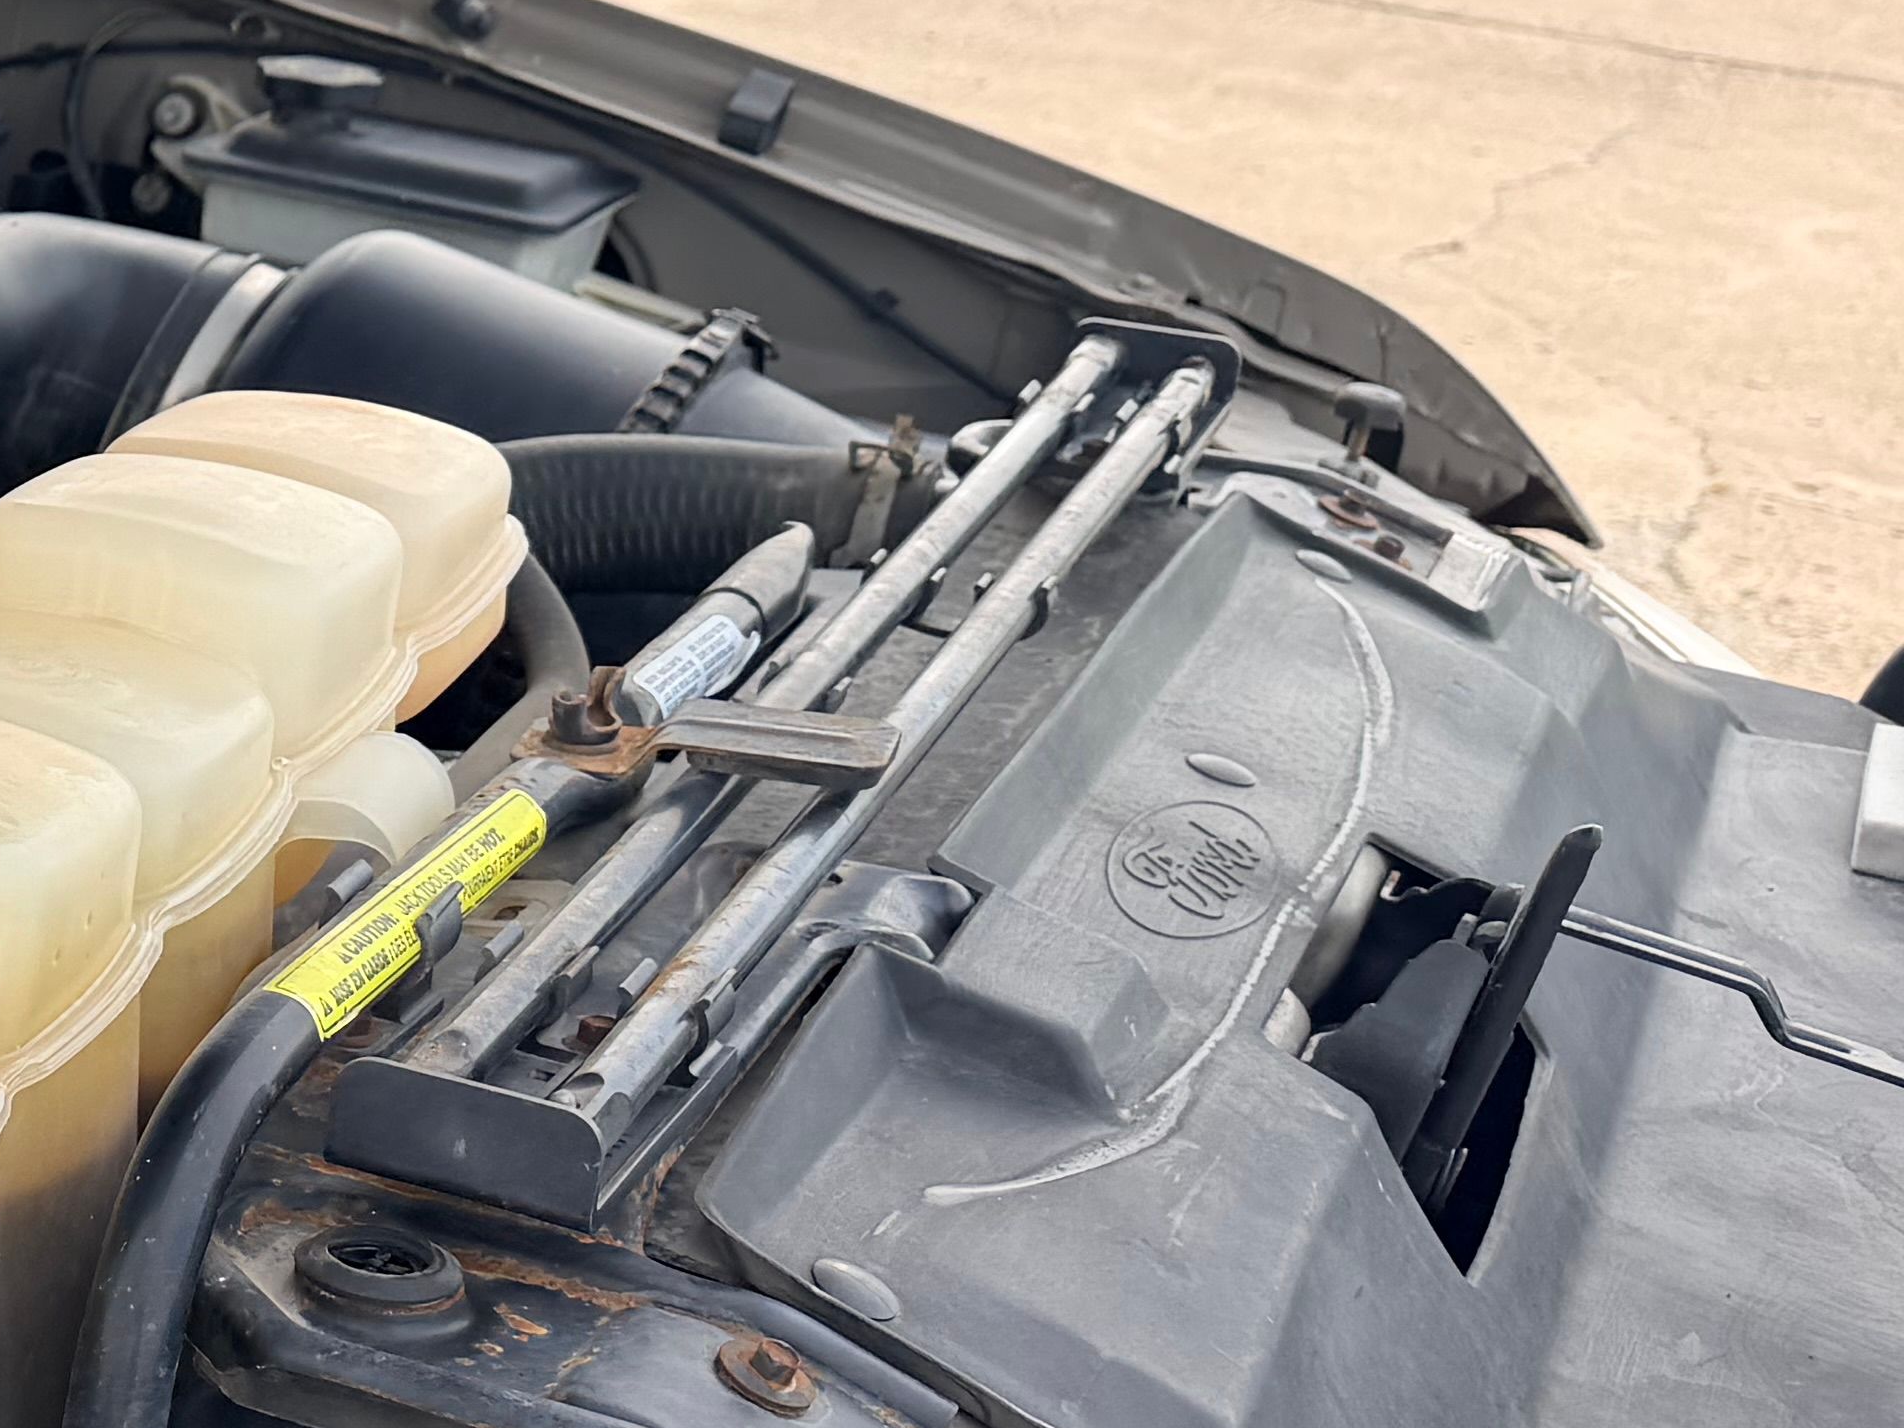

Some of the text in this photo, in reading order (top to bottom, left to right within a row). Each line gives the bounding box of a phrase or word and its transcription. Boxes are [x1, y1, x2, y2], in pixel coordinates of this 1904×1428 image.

[343, 828, 506, 955] CAUTION: JACK TOOLS MAY BE HOT.
